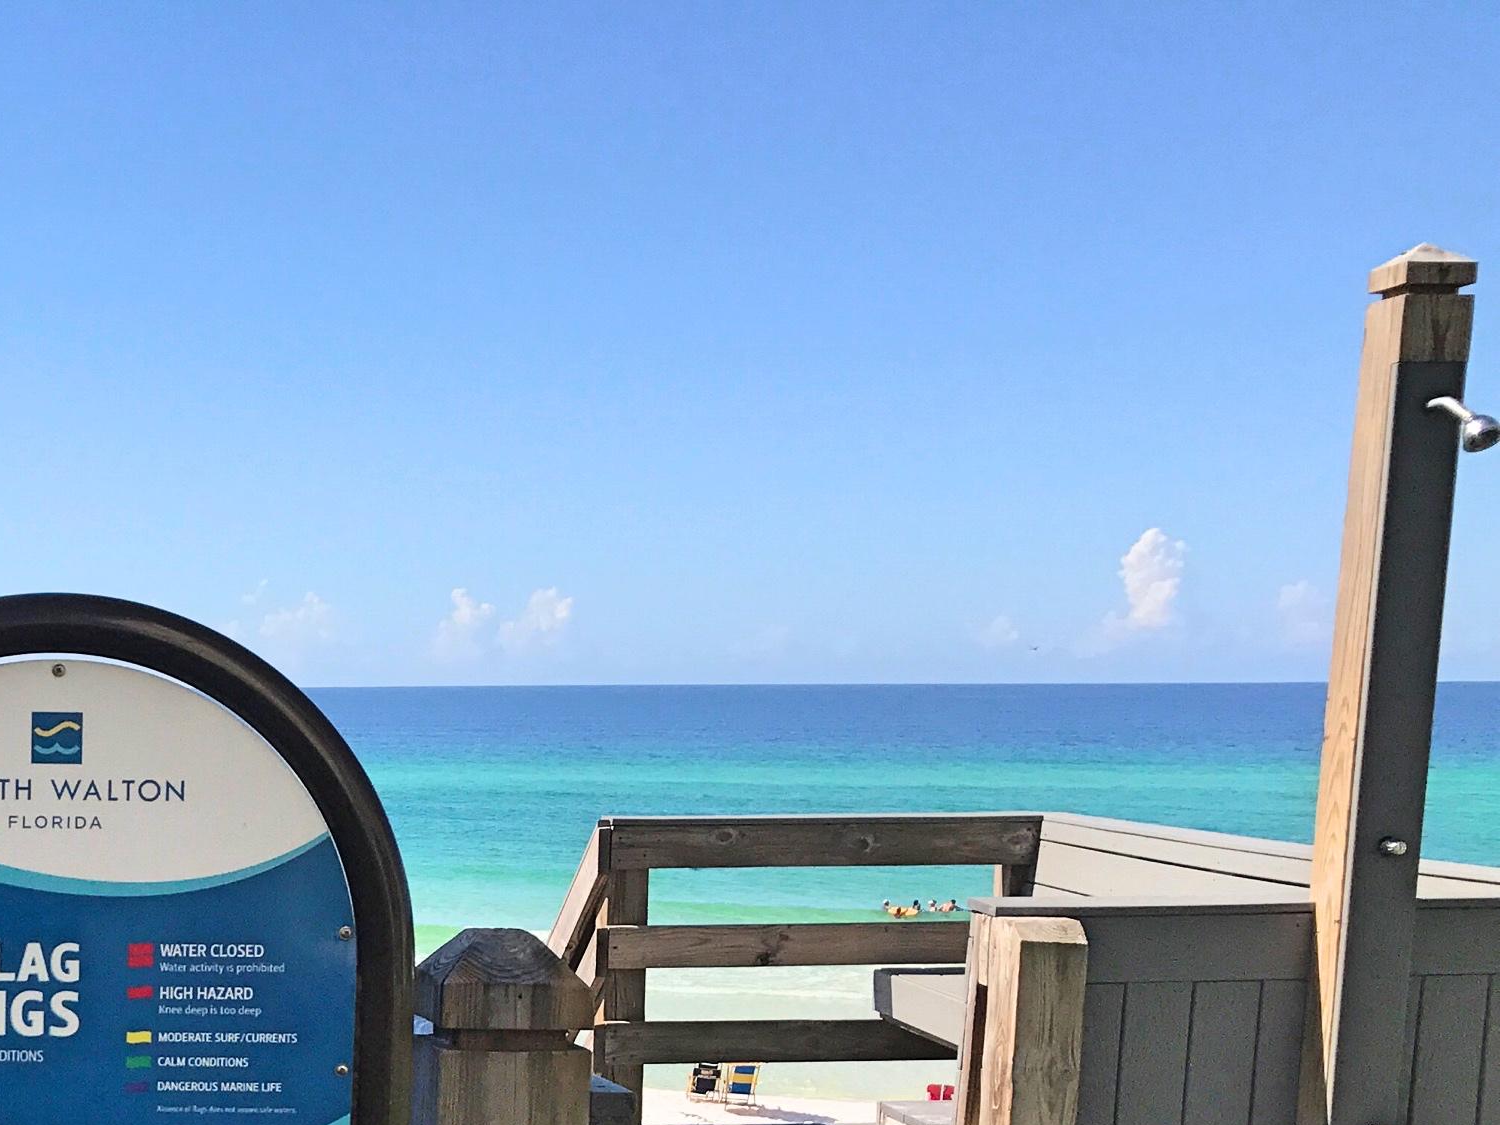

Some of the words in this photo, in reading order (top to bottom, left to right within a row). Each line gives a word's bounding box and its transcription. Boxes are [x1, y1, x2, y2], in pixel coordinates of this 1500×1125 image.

[52, 779, 185, 802] WALTON
[8, 816, 102, 829] FLORIDA
[160, 944, 206, 957] WATER
[211, 944, 264, 957] CLOSED
[160, 963, 186, 972] Water
[190, 963, 223, 973] activity
[227, 964, 233, 972] is
[237, 963, 285, 974] prohibited
[160, 987, 193, 999] HIGH
[197, 987, 253, 1000] HAZARD
[159, 1006, 182, 1014] Knee
[185, 1006, 208, 1016] deep
[210, 1006, 217, 1014] is
[239, 1006, 261, 1017] deep
[158, 1032, 212, 1042] MODERATE
[215, 1033, 297, 1043] SURF/CURRENTS
[157, 1057, 185, 1066] CALM
[188, 1057, 249, 1067] CONDITIONS
[157, 1082, 218, 1091] DANGEROUS
[221, 1082, 259, 1092] MARINE
[261, 1083, 282, 1092] LIFE
